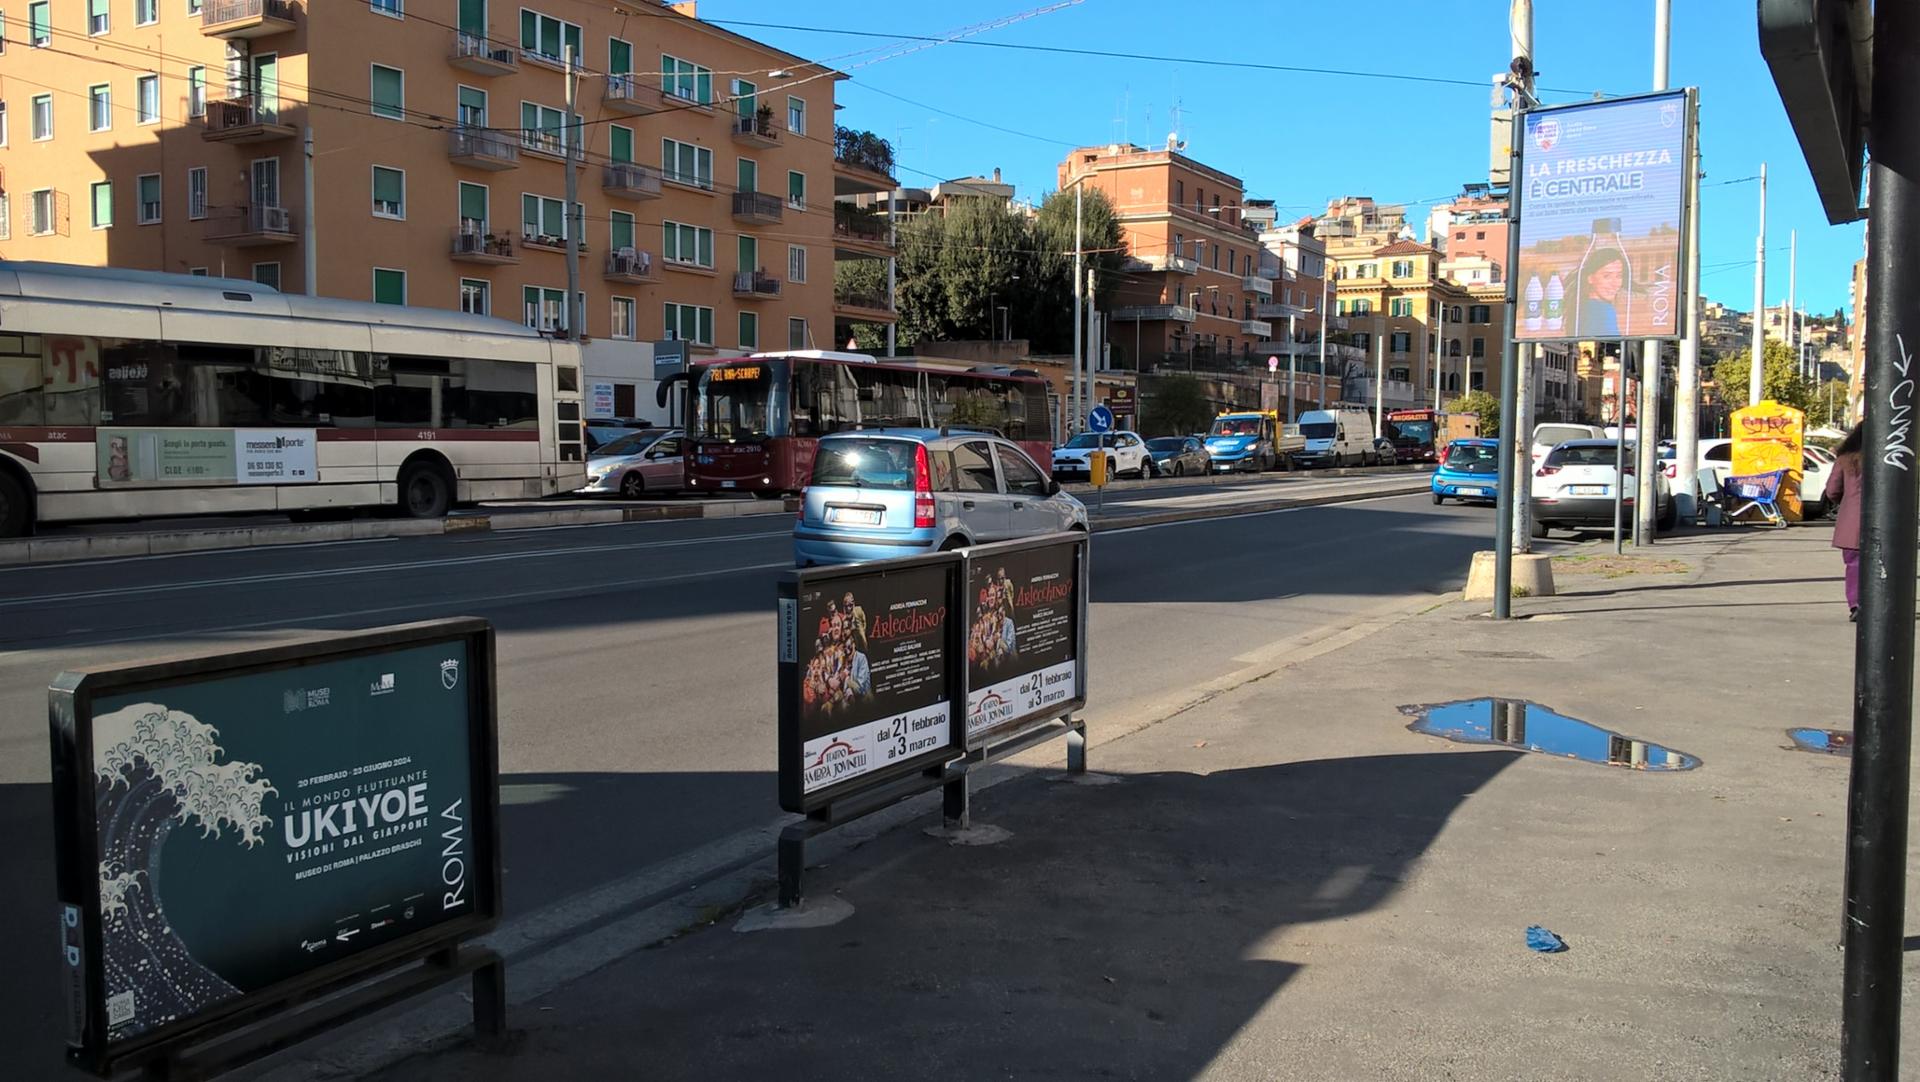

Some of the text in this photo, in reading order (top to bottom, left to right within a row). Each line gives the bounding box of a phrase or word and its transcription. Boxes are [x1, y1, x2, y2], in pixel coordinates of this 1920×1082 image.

[1530, 149, 1672, 177] LA FRESCHEZZA
[1530, 172, 1643, 199] È CENTRALE
[1653, 264, 1671, 327] ROMA
[48, 431, 67, 439] atac
[286, 439, 305, 448] porte
[417, 431, 436, 440] 4191
[308, 688, 330, 697] MUSEI
[1020, 670, 1072, 695] dal 21 febbraio
[1028, 689, 1065, 709] al 3 marzo
[877, 728, 891, 742] dal
[892, 716, 908, 738] 21
[912, 713, 946, 732] febbraio
[888, 735, 937, 759] al 3 marzo
[298, 779, 308, 788] 20
[310, 770, 348, 786] FEBBRAIO
[353, 766, 363, 776] 23
[363, 760, 393, 775] GIUGNO
[393, 756, 412, 768] 2024
[284, 770, 428, 812] IL MONDO FLUTTUANTE
[285, 782, 429, 849] UKIYOE
[287, 817, 429, 864] VISIONI DAL GIAPPONE
[441, 798, 465, 910] ROMA
[296, 866, 322, 880] MUSEO
[323, 863, 333, 873] DI
[333, 857, 355, 870] ROMA
[359, 847, 391, 863] PALAZZO
[392, 838, 422, 854] BRASCHI
